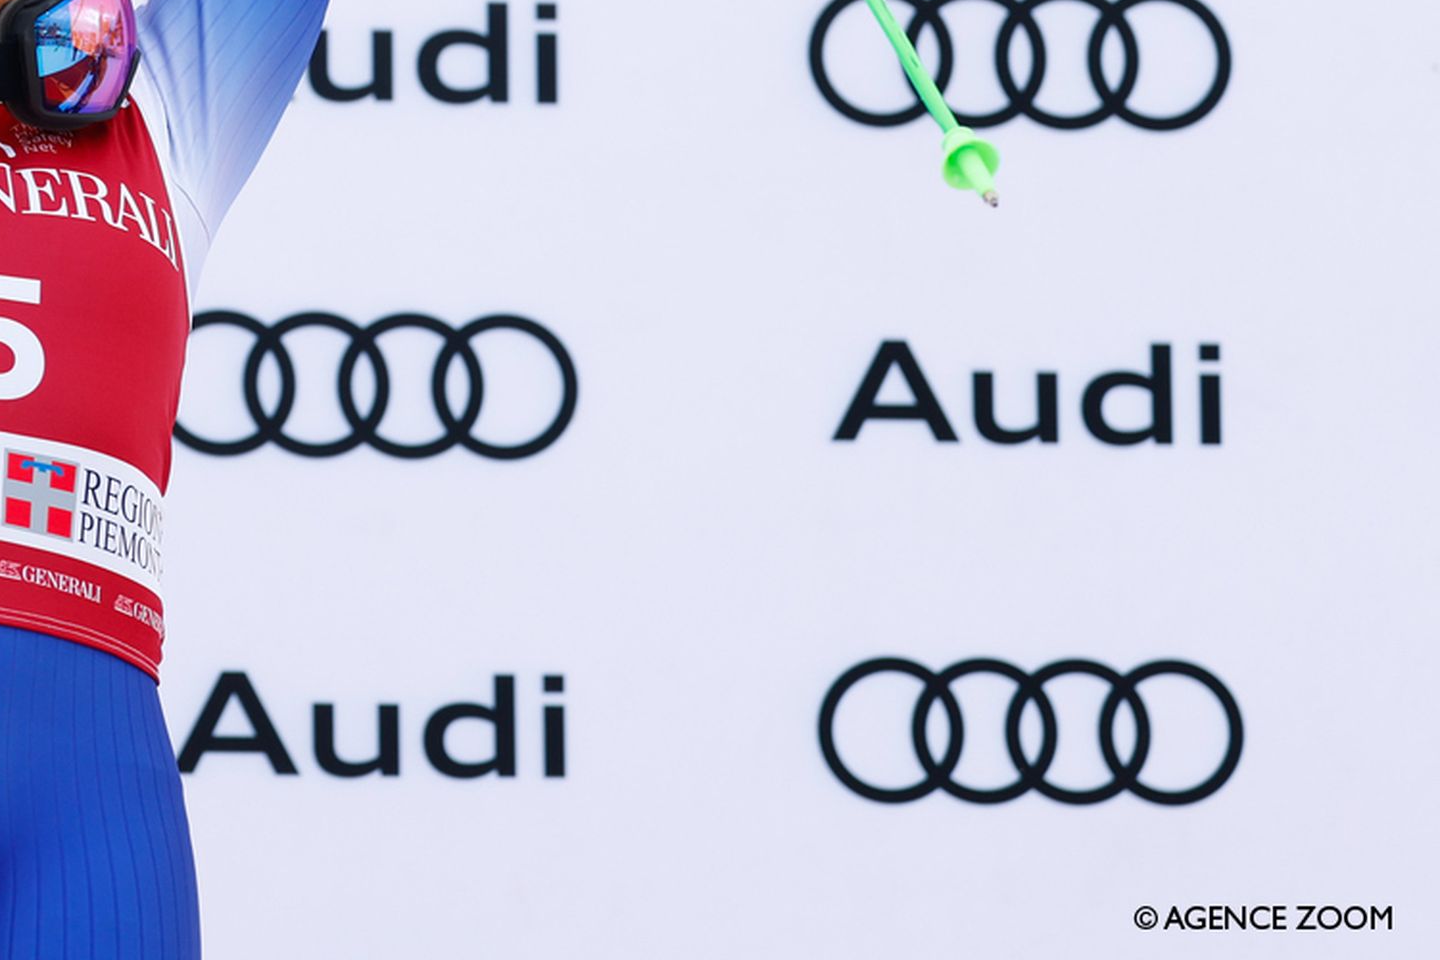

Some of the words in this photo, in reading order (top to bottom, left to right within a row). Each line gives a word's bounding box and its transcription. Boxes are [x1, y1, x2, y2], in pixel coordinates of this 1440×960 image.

[307, 1, 558, 106] udi
[832, 339, 1222, 447] Audi
[22, 565, 103, 604] GENERALI
[177, 670, 566, 780] Audi
